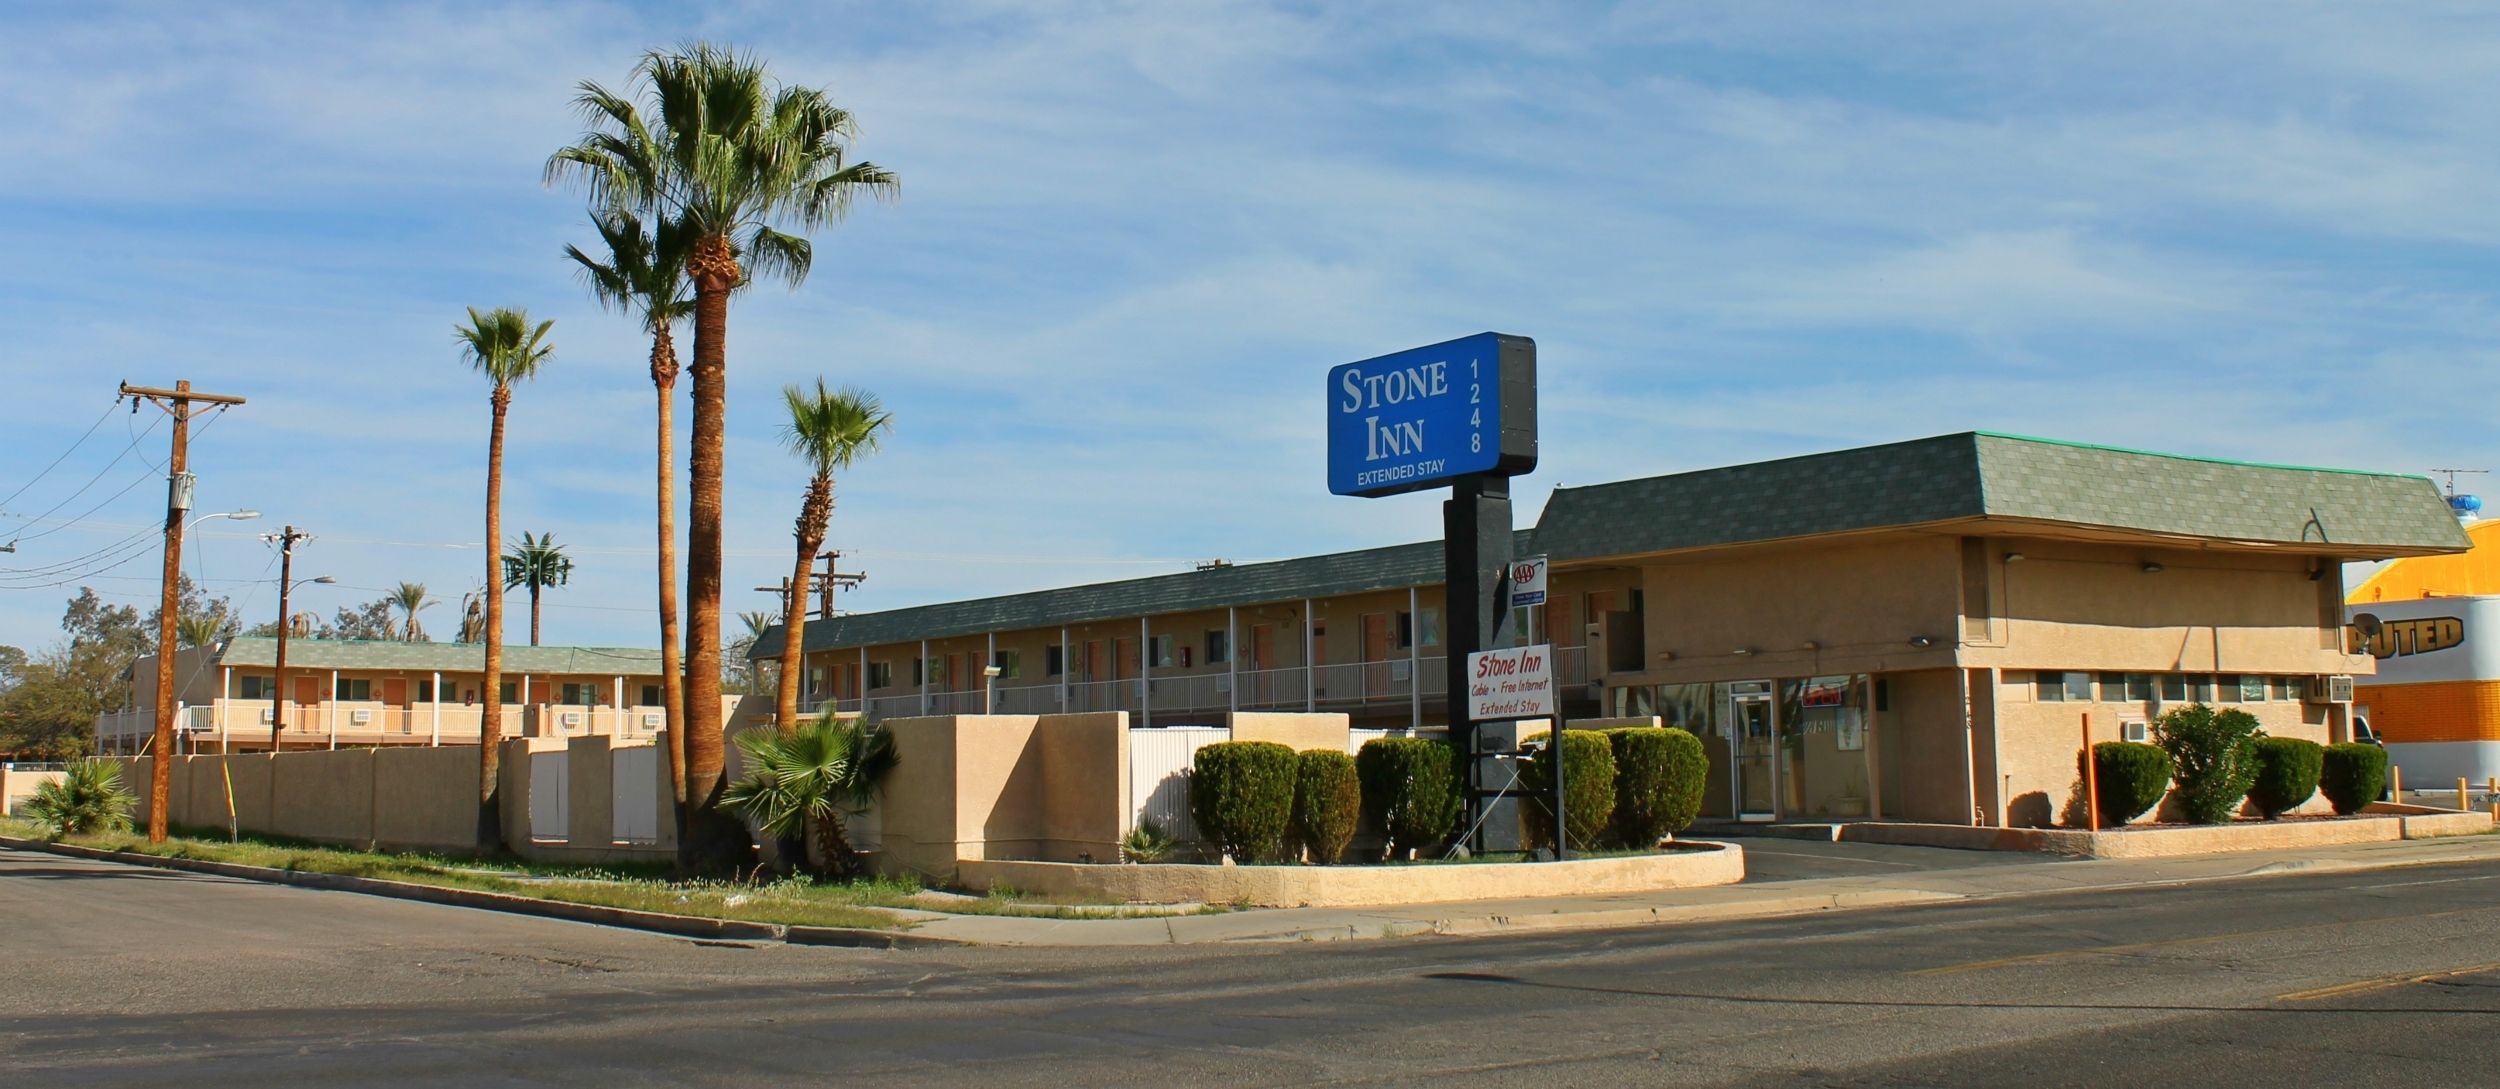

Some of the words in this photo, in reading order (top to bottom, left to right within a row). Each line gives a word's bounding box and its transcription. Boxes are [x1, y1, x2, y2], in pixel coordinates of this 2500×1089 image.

[1342, 361, 1448, 414] STONE
[1365, 416, 1425, 462] INN
[1357, 464, 1415, 486] EXTENDED
[1417, 459, 1445, 476] STAY
[1514, 565, 1534, 583] AAA
[1477, 652, 1516, 679] Stone
[1520, 649, 1542, 673] Inn
[1471, 683, 1489, 696] Cable
[1501, 680, 1516, 693] Free
[1518, 677, 1549, 692] Internet
[1480, 699, 1519, 715] Extended
[1521, 698, 1541, 715] Stay
